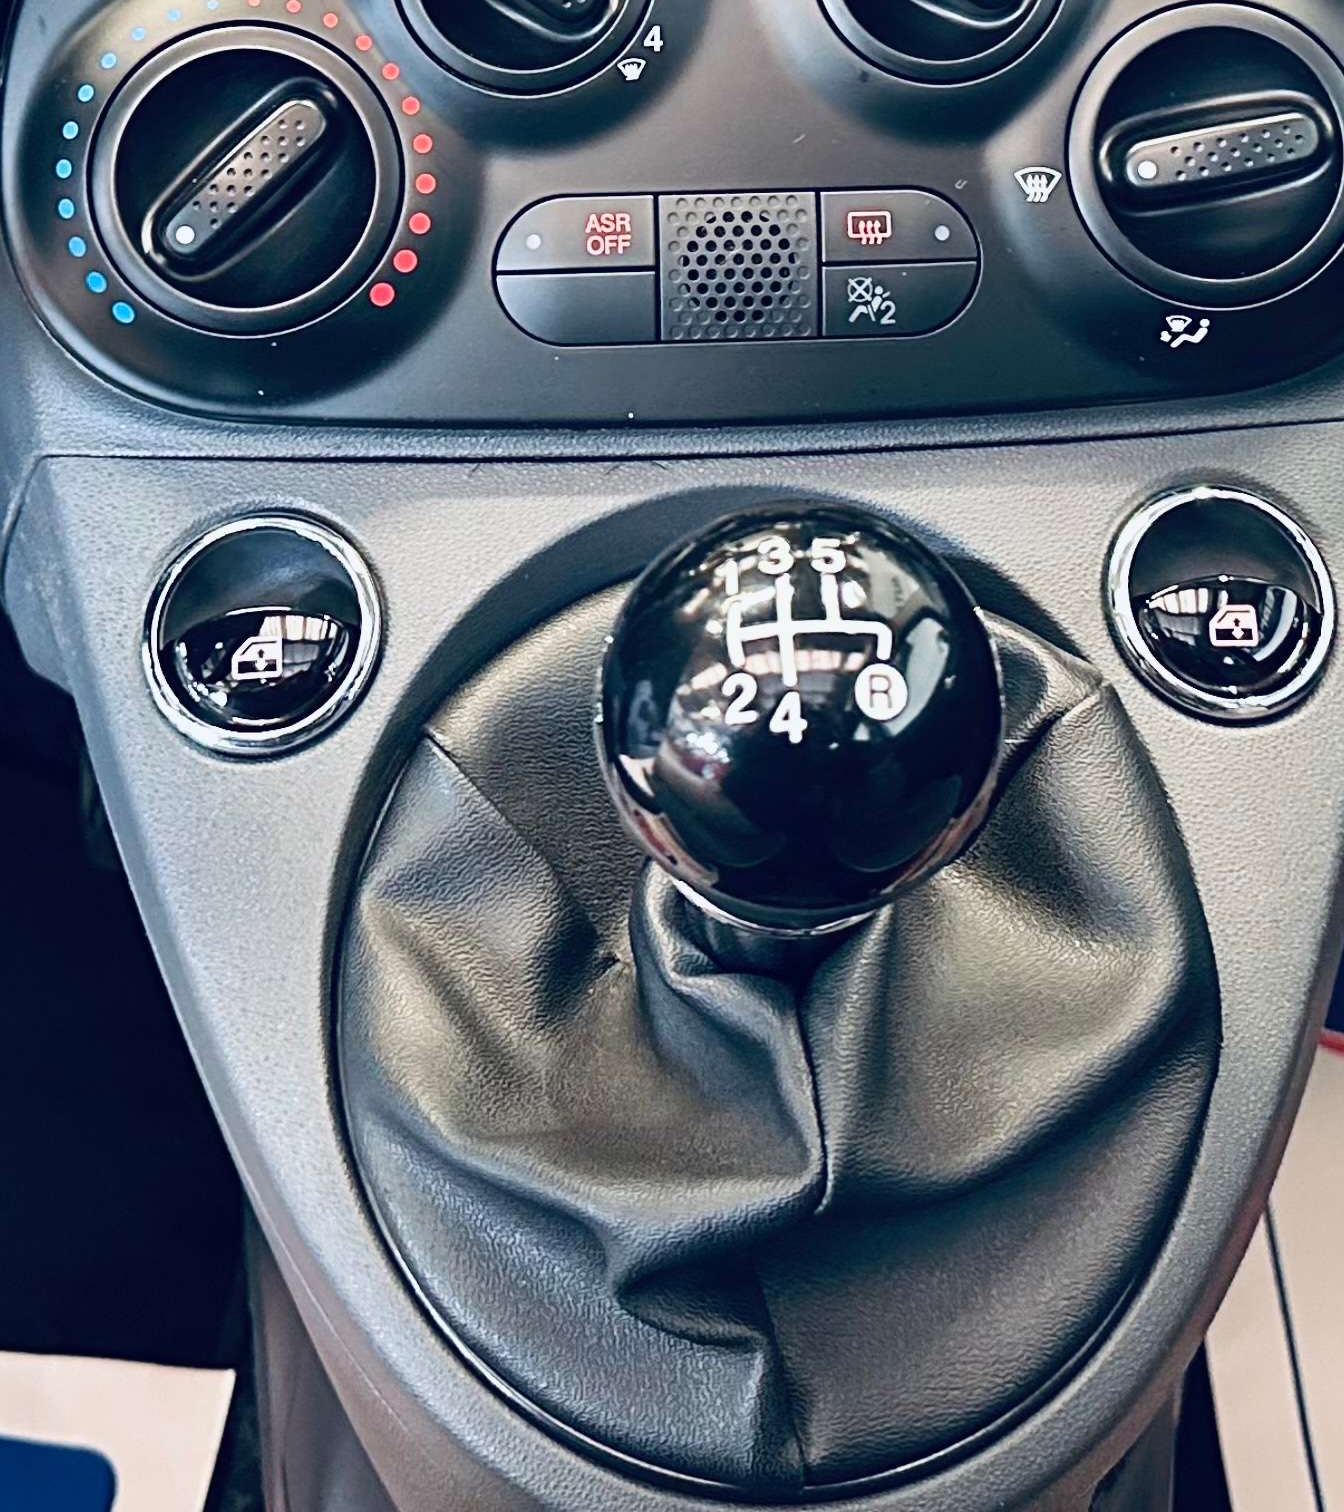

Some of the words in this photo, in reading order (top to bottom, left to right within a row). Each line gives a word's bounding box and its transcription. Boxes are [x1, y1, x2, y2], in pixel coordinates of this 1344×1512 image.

[643, 25, 664, 52] 4
[584, 213, 633, 234] ASR
[585, 234, 632, 255] OFF
[713, 559, 739, 595] 1
[757, 536, 795, 575] 3
[809, 538, 847, 574] 5
[721, 672, 758, 726] 2
[768, 690, 808, 745] 4
